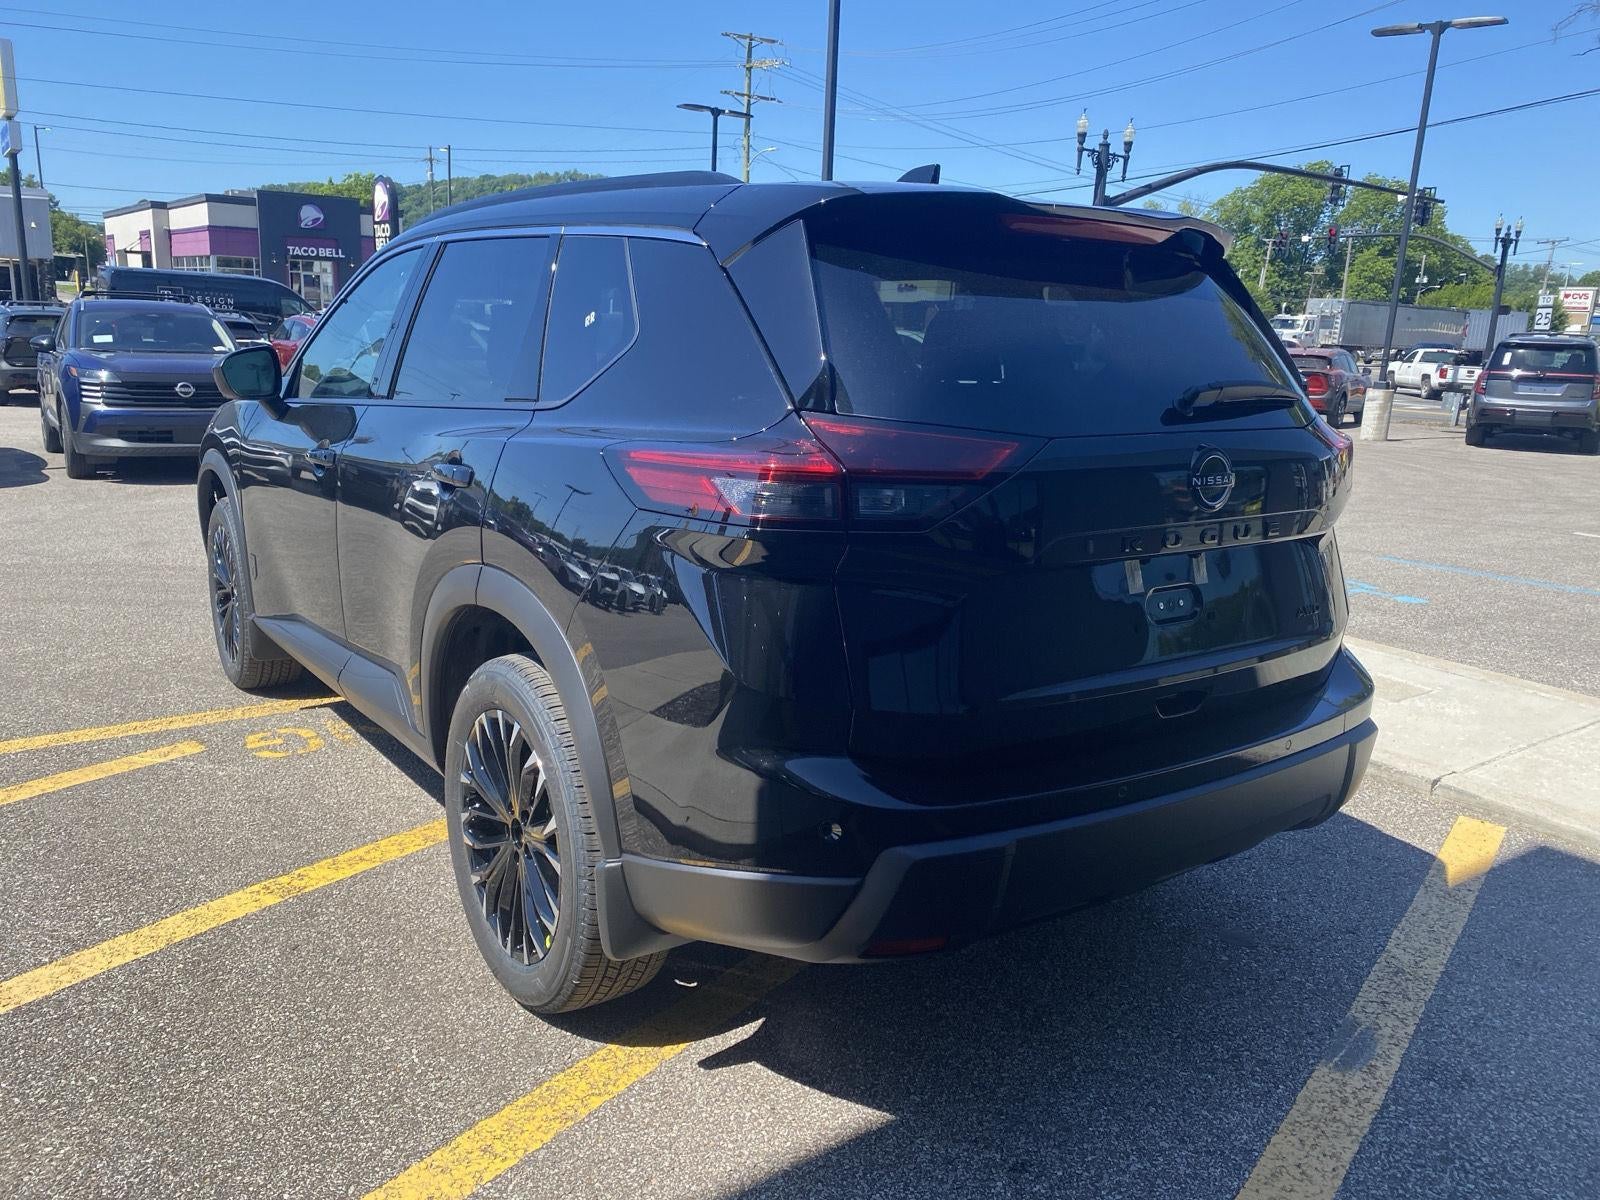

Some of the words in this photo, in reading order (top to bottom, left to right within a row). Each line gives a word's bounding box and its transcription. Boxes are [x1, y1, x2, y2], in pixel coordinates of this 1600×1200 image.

[374, 223, 390, 238] TACO
[287, 245, 317, 256] TACO
[318, 247, 345, 258] BELL
[1536, 313, 1551, 326] 25
[1192, 474, 1234, 486] NISSAN
[1120, 520, 1280, 553] ROGUE
